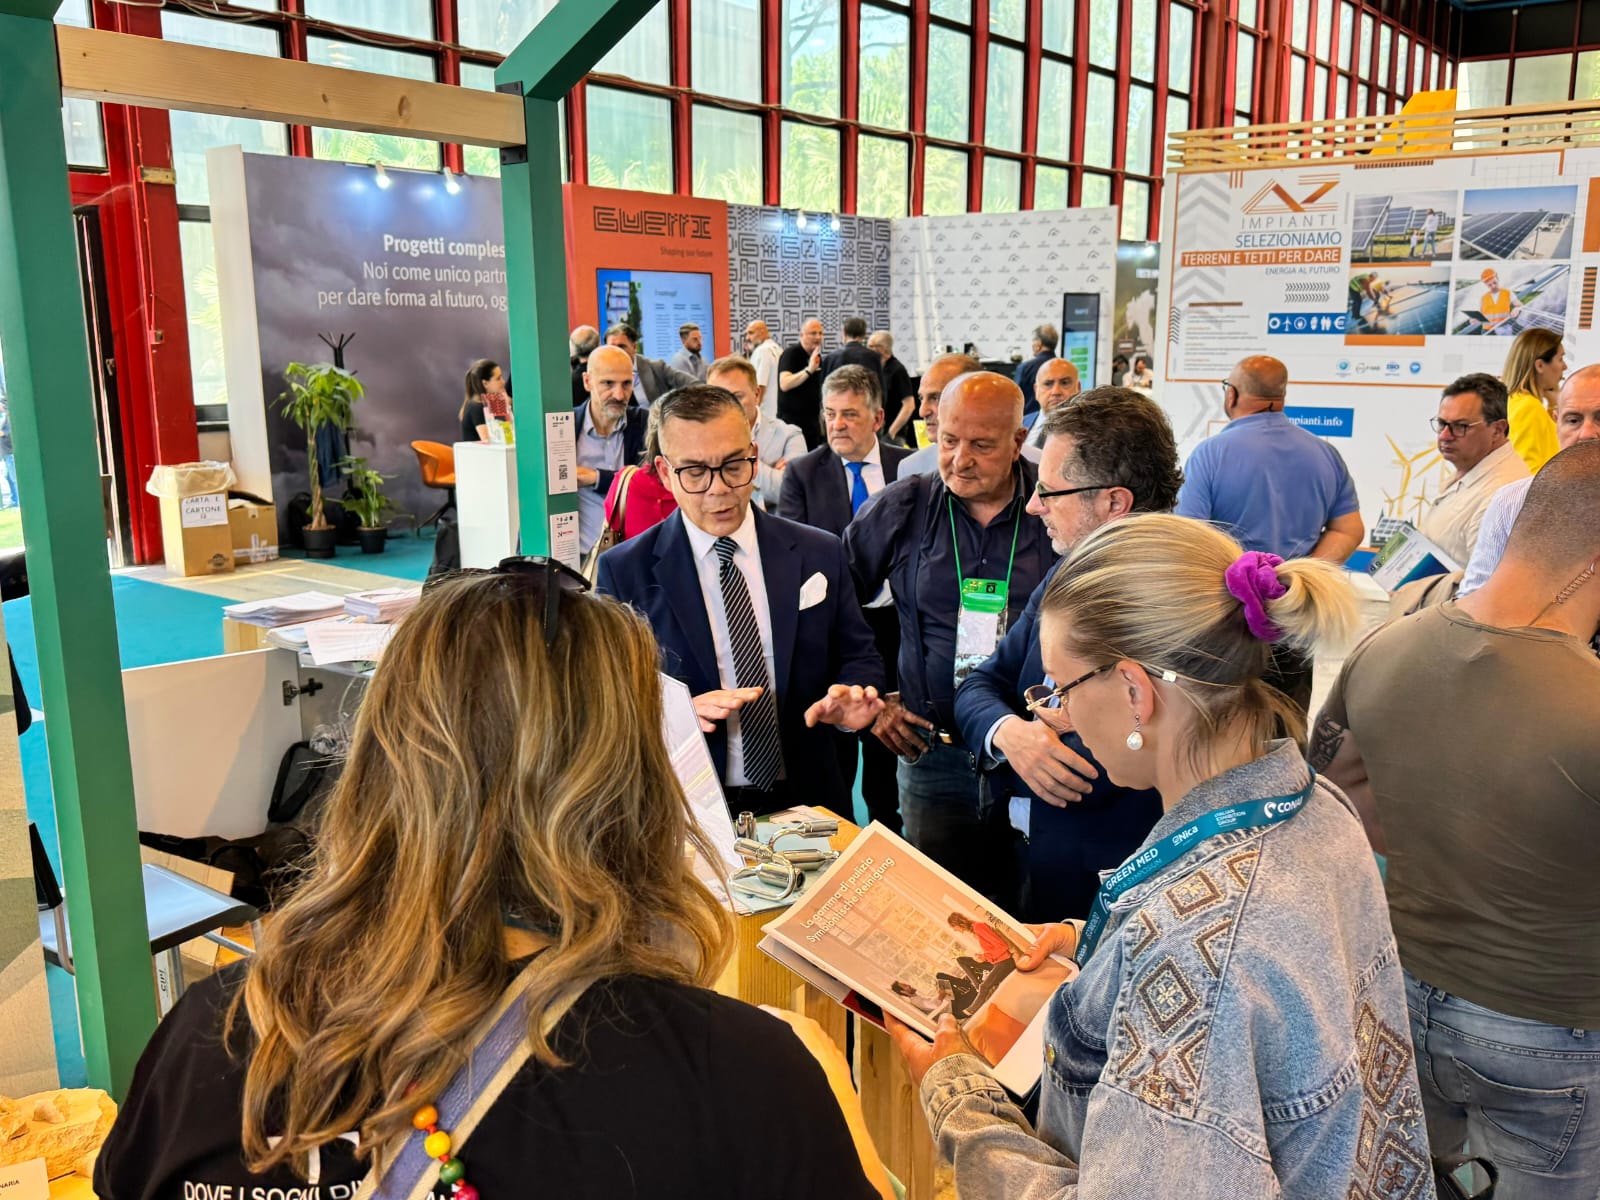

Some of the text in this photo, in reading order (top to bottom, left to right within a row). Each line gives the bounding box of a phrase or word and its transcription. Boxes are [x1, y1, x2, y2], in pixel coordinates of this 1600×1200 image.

[1241, 214, 1336, 229] IMPIANTI
[383, 233, 445, 257] Progetti
[1235, 231, 1342, 248] SELEZIONIAMO
[1184, 249, 1340, 266] TERRENI E TETTI PER DARE
[363, 261, 388, 280] Noi
[392, 266, 431, 281] come
[434, 264, 471, 282] unico
[1265, 265, 1340, 276] ENERGIA AL FUTURO
[317, 290, 343, 309] per
[347, 287, 381, 306] dare
[385, 287, 427, 308] forma
[430, 289, 443, 308] al
[446, 290, 488, 310] futuro,
[185, 506, 221, 514] CARTONE
[855, 857, 896, 898] Reinigung
[1105, 848, 1159, 890] GREEN MED
[800, 857, 874, 929] La gamma di pulizia
[183, 1180, 232, 1200] DOVE
